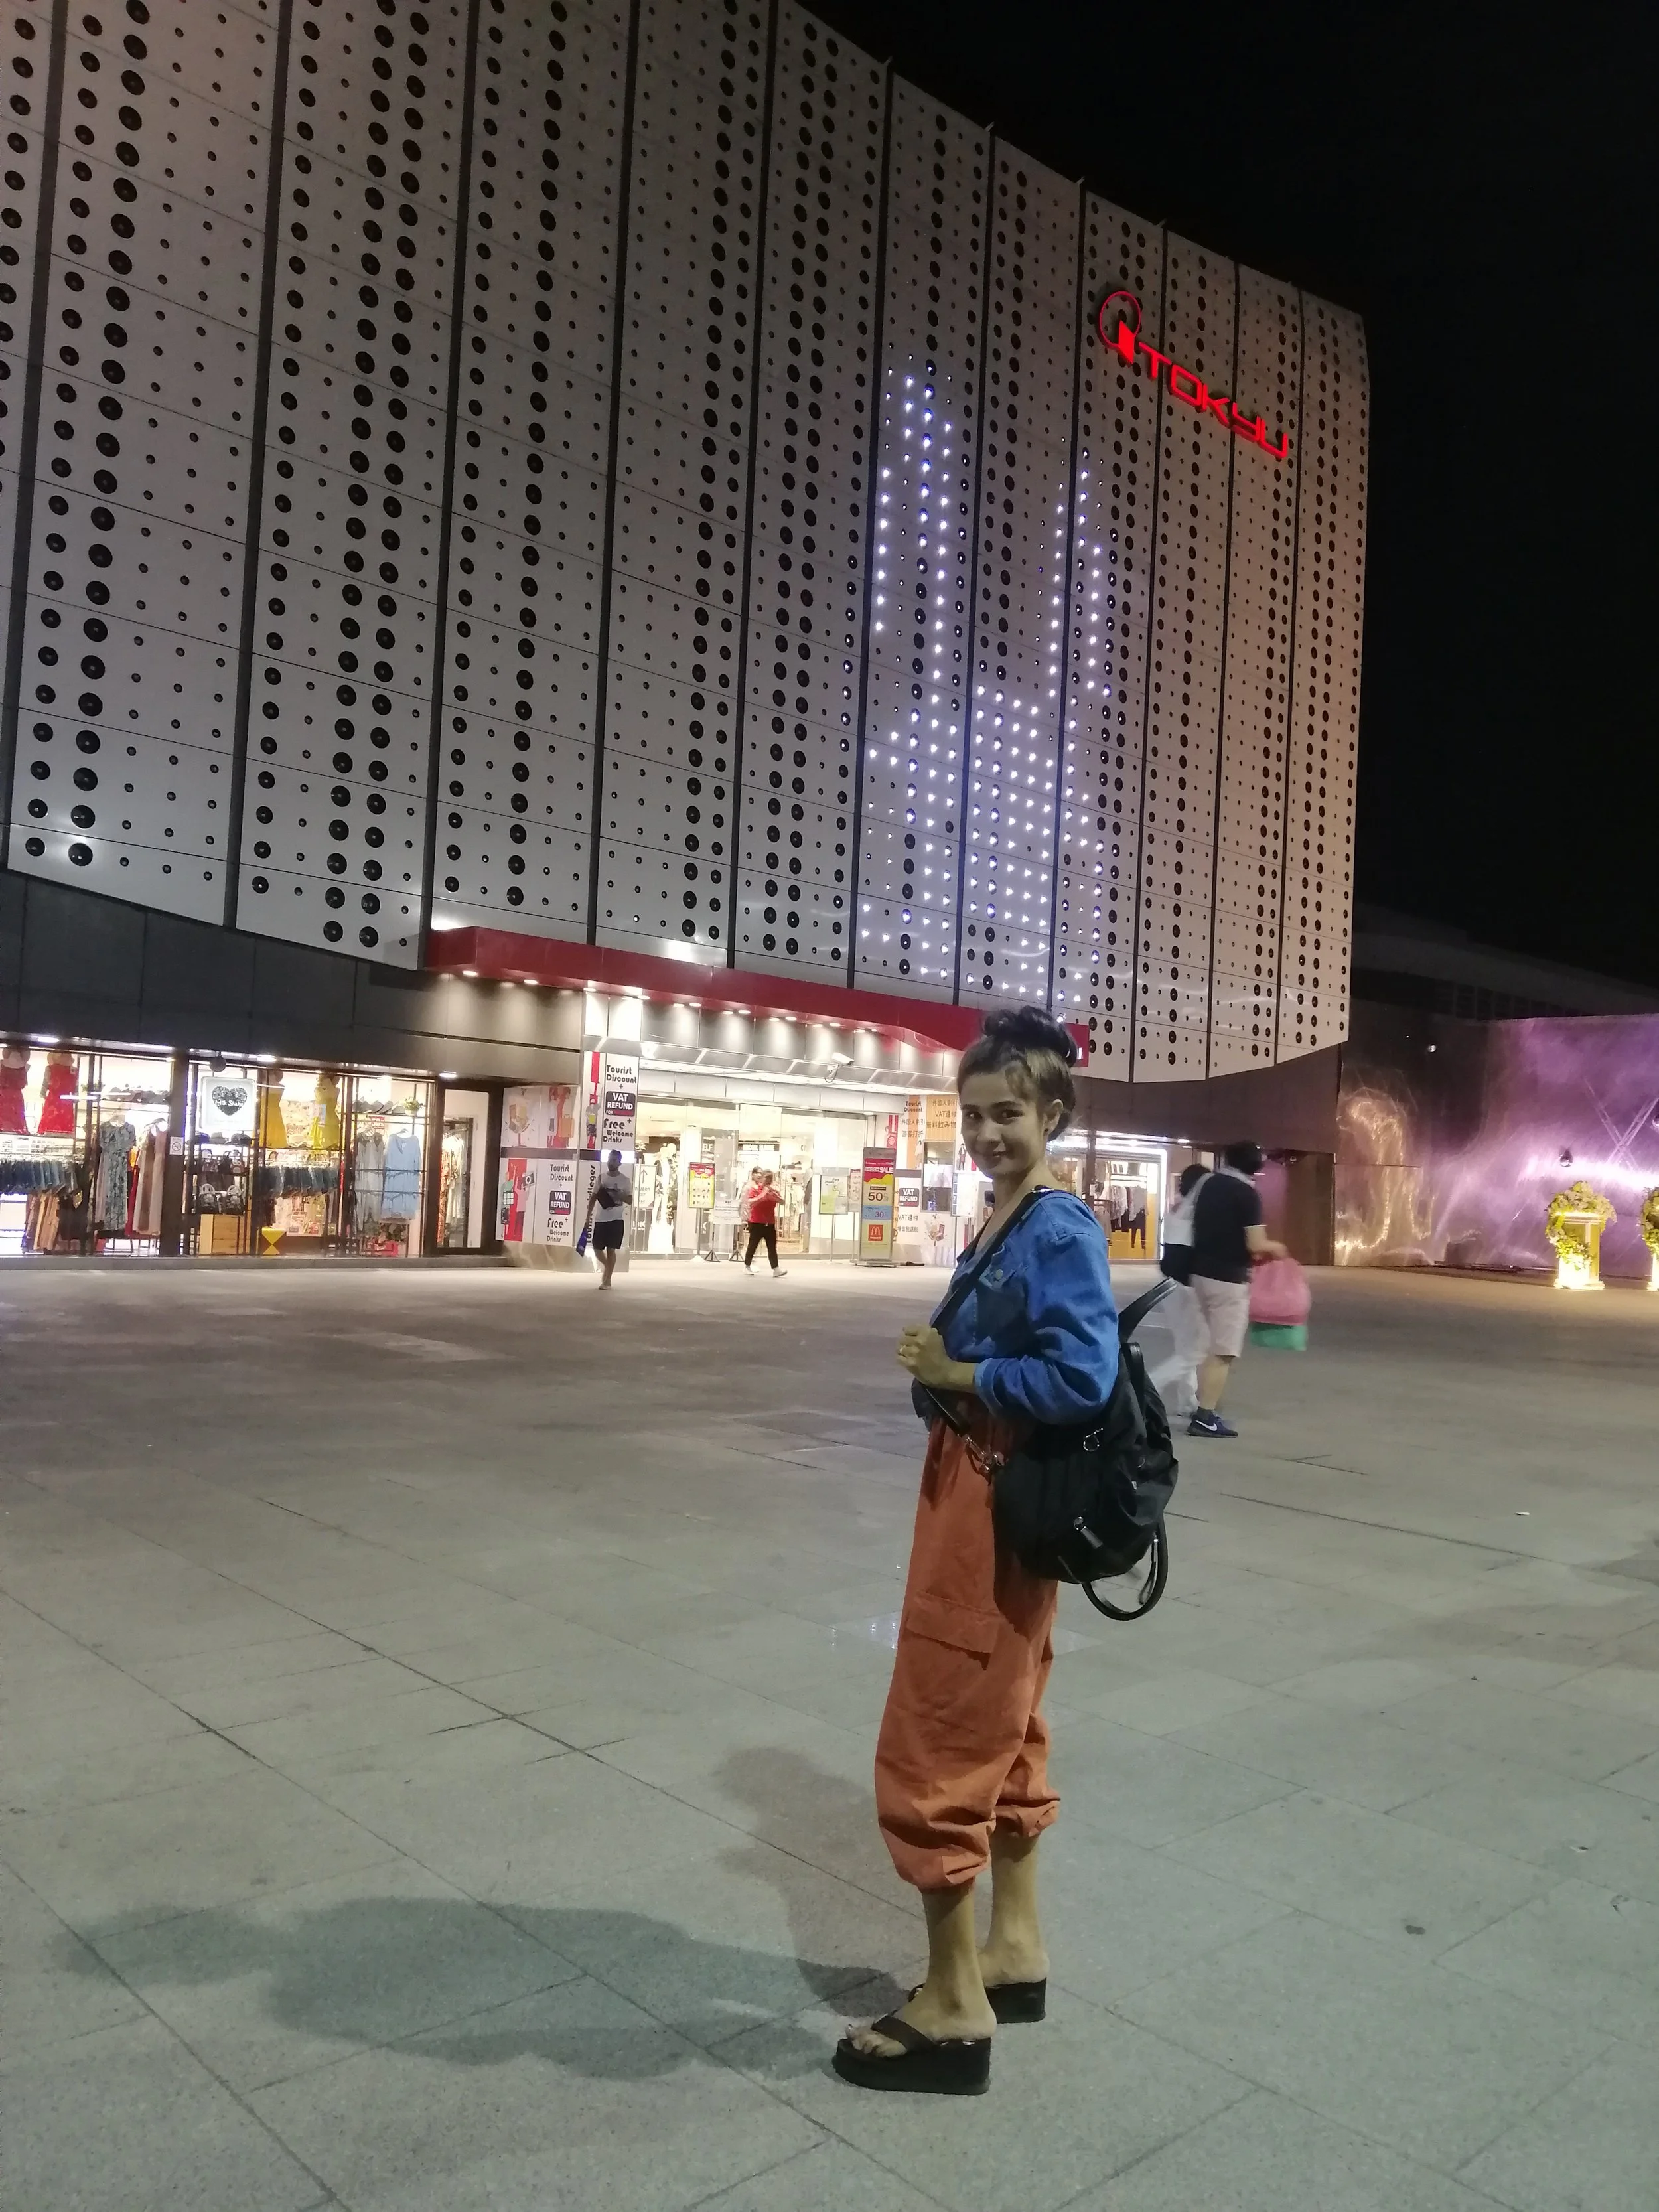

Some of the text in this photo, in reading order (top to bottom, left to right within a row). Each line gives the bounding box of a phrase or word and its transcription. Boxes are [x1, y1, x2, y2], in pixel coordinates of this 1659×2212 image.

[1137, 341, 1288, 459] TOKYU
[607, 1065, 632, 1074] Tourist
[606, 1074, 637, 1084] Discount
[613, 1092, 628, 1102] VAT
[607, 1101, 633, 1110] REFUND
[603, 1118, 625, 1130] Free
[550, 1164, 569, 1173] Tourist
[555, 1192, 567, 1201] VAT
[547, 1218, 563, 1228] Free
